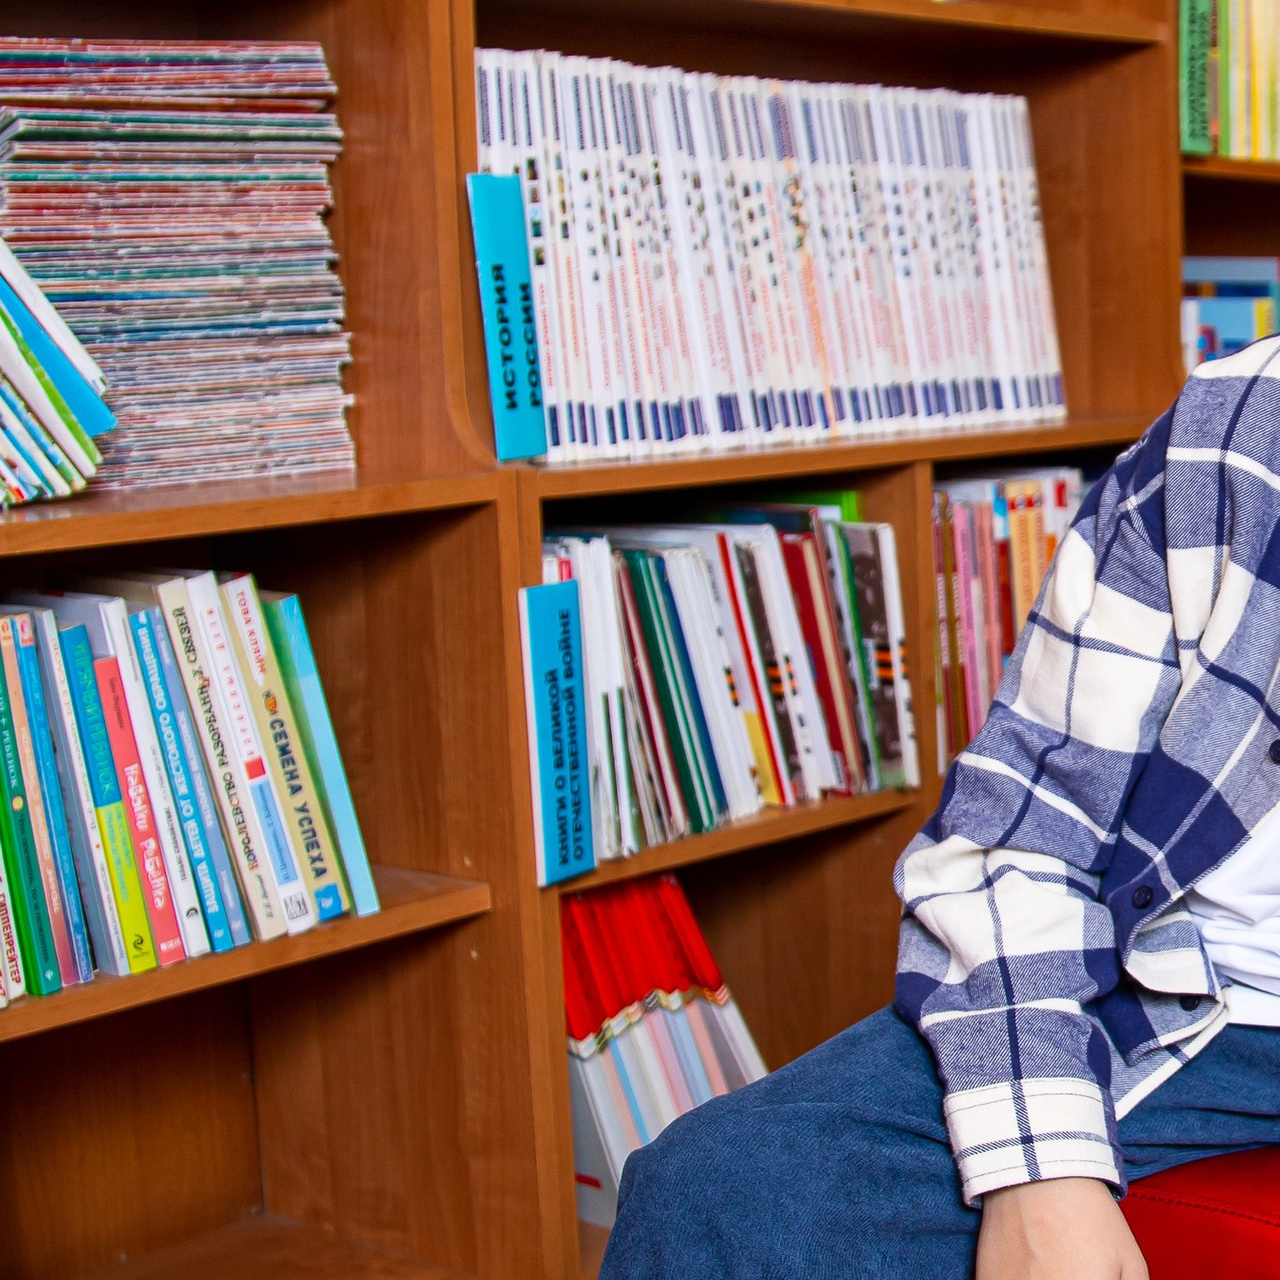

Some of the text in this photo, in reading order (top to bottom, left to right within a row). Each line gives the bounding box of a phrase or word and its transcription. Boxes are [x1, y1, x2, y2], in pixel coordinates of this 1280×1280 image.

[491, 262, 517, 410] ИСТОРИЯ
[518, 282, 541, 407] РОССИИ
[136, 625, 168, 711] ОБРАЩЕНИЯ
[234, 590, 268, 675] ТОВА КЛЯЙН
[71, 641, 100, 722] УПРЯМЫЙ
[0, 729, 20, 789] РЕБЕНОК
[157, 711, 189, 796] ЖЕСТОКОГО
[169, 606, 261, 871] КОРОЛЕВСТВО РАЗОРВАННЫХ СВЯЗЕЙ
[544, 668, 569, 866] КНИГИ О ВЕЛИКОЙ
[556, 608, 583, 860] ОТЕЧЕСТВЕННОЙ ВОЙНЕ
[178, 797, 195, 818] ОТ
[184, 818, 206, 859] ДЕТЕЙ
[267, 716, 328, 878] СЕМЕНА УСПЕХА
[194, 860, 219, 914] ЗАЩИТА
[0, 893, 22, 984] ГИППЕНРЕЙТЕР
